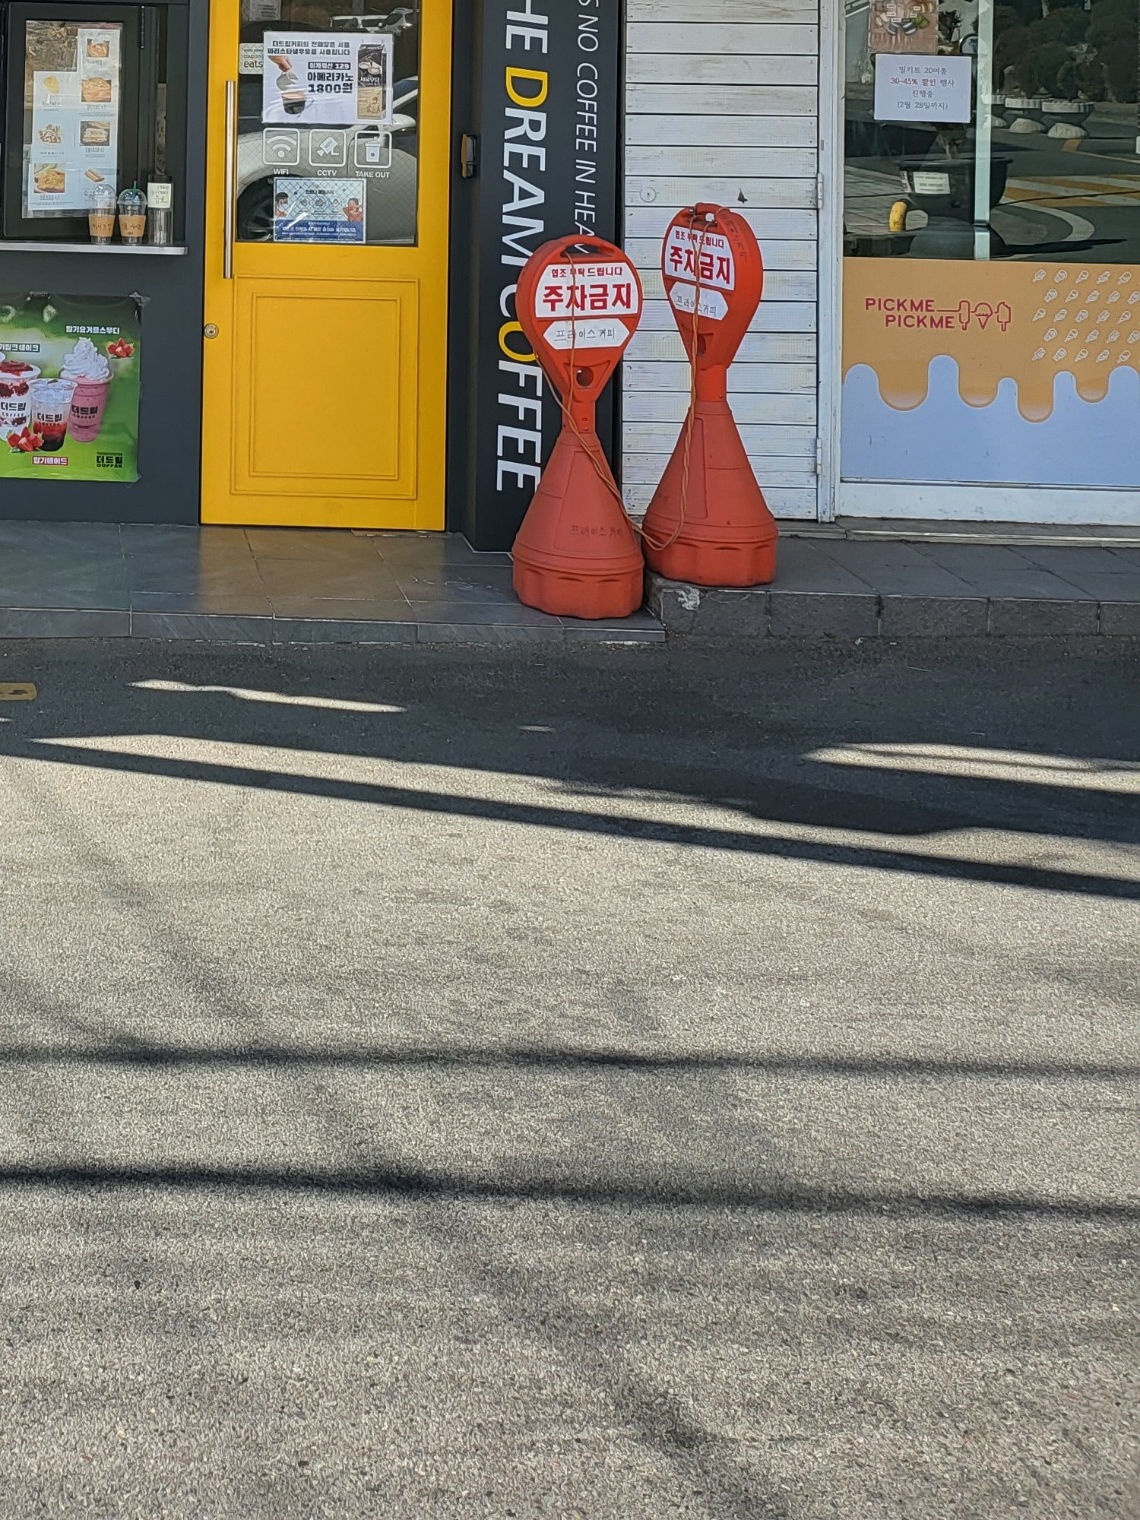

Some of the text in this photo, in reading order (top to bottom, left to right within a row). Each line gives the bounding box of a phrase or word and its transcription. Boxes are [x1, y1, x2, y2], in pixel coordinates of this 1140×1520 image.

[576, 14, 599, 52] NO
[307, 72, 354, 82] 아메리카노
[308, 82, 354, 94] 1800원
[575, 60, 598, 151] COFFEE
[501, 65, 549, 265] DREAM
[317, 169, 338, 177] CCTV
[355, 170, 373, 178] TAKE
[573, 159, 597, 186] IN
[668, 245, 731, 285] 주차금지
[587, 266, 623, 278] 드립니다
[542, 282, 632, 312] 주차금지
[0, 401, 27, 412] 더드림
[71, 405, 98, 415] 더드림
[36, 412, 63, 422] 더드림
[96, 455, 123, 464] 더드림
